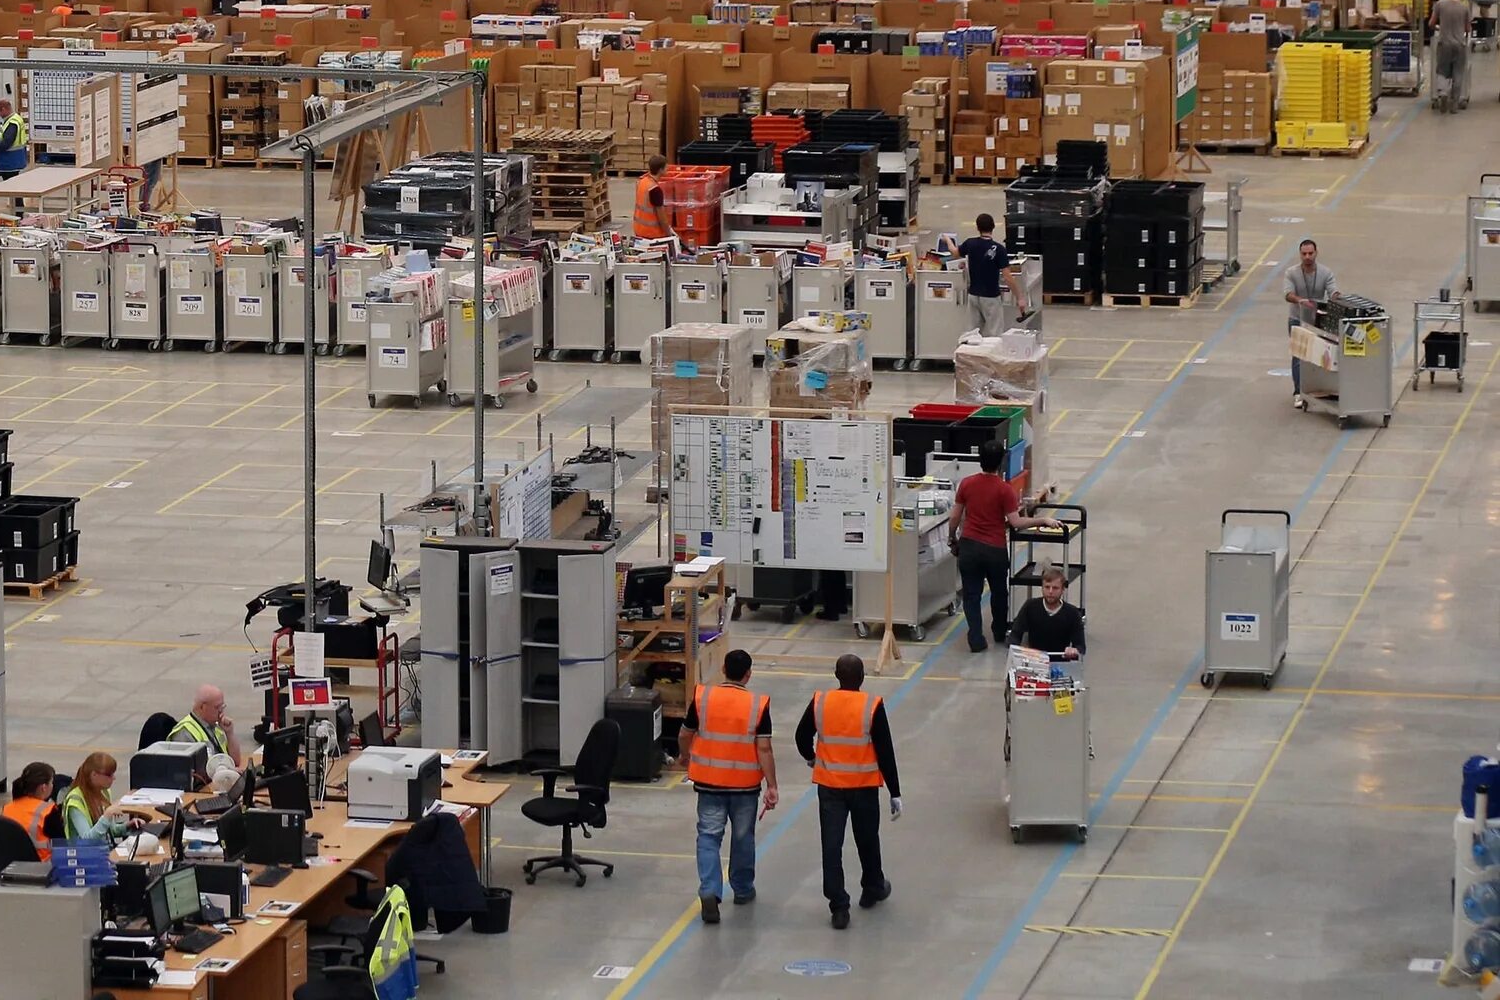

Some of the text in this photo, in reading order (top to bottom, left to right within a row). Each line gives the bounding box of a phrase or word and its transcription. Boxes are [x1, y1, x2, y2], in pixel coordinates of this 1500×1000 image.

[79, 301, 93, 309] 257
[184, 303, 199, 312] 209
[242, 305, 256, 313] 261
[389, 356, 399, 365] 74
[1230, 624, 1252, 633] 1022
